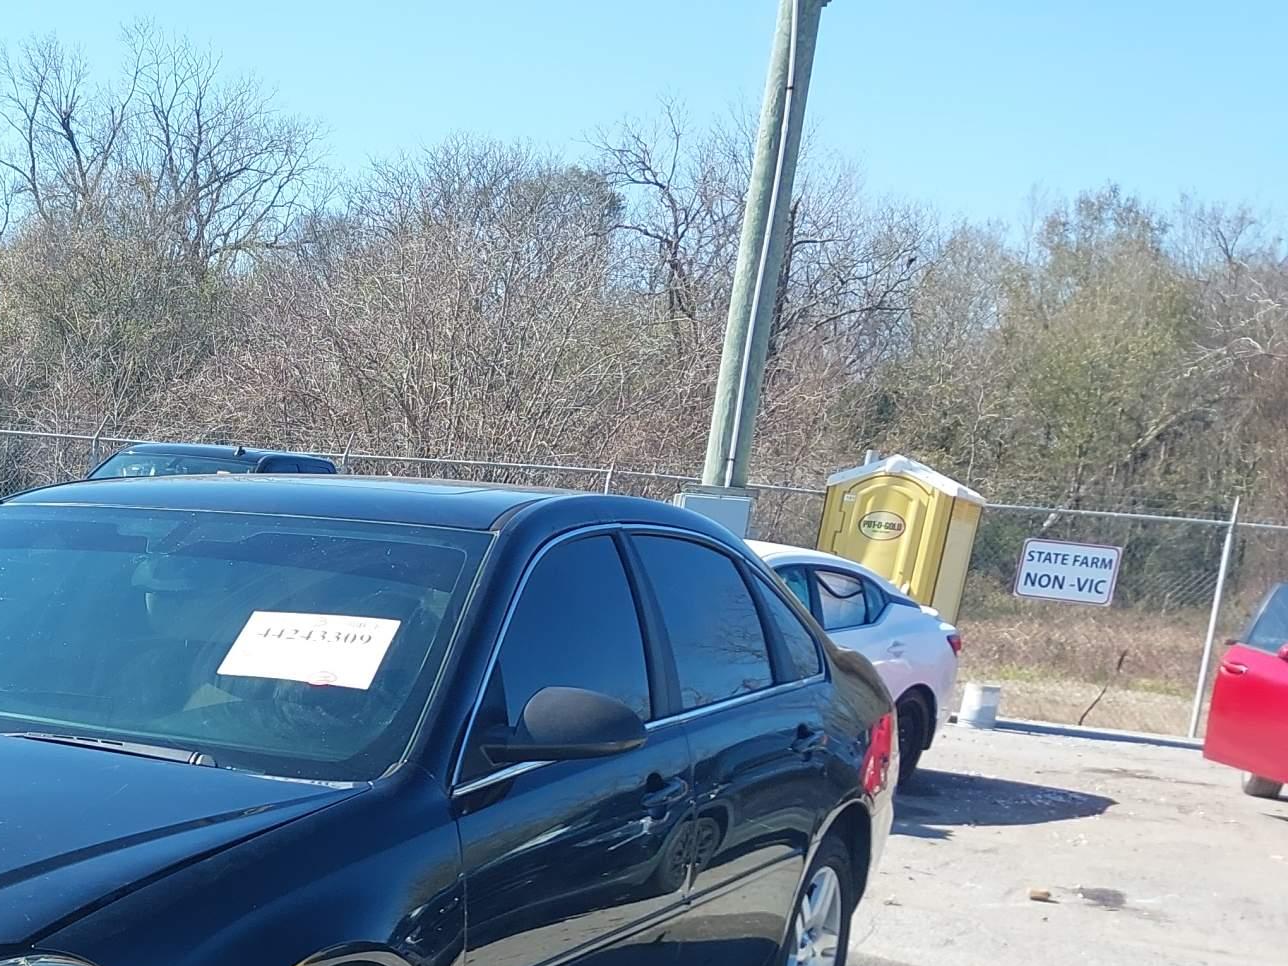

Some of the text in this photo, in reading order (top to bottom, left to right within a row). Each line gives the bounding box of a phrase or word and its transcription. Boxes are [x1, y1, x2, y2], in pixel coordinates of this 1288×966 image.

[1026, 550, 1113, 570] STATE FARM
[1023, 571, 1066, 590] NON
[256, 627, 373, 645] 44243309
